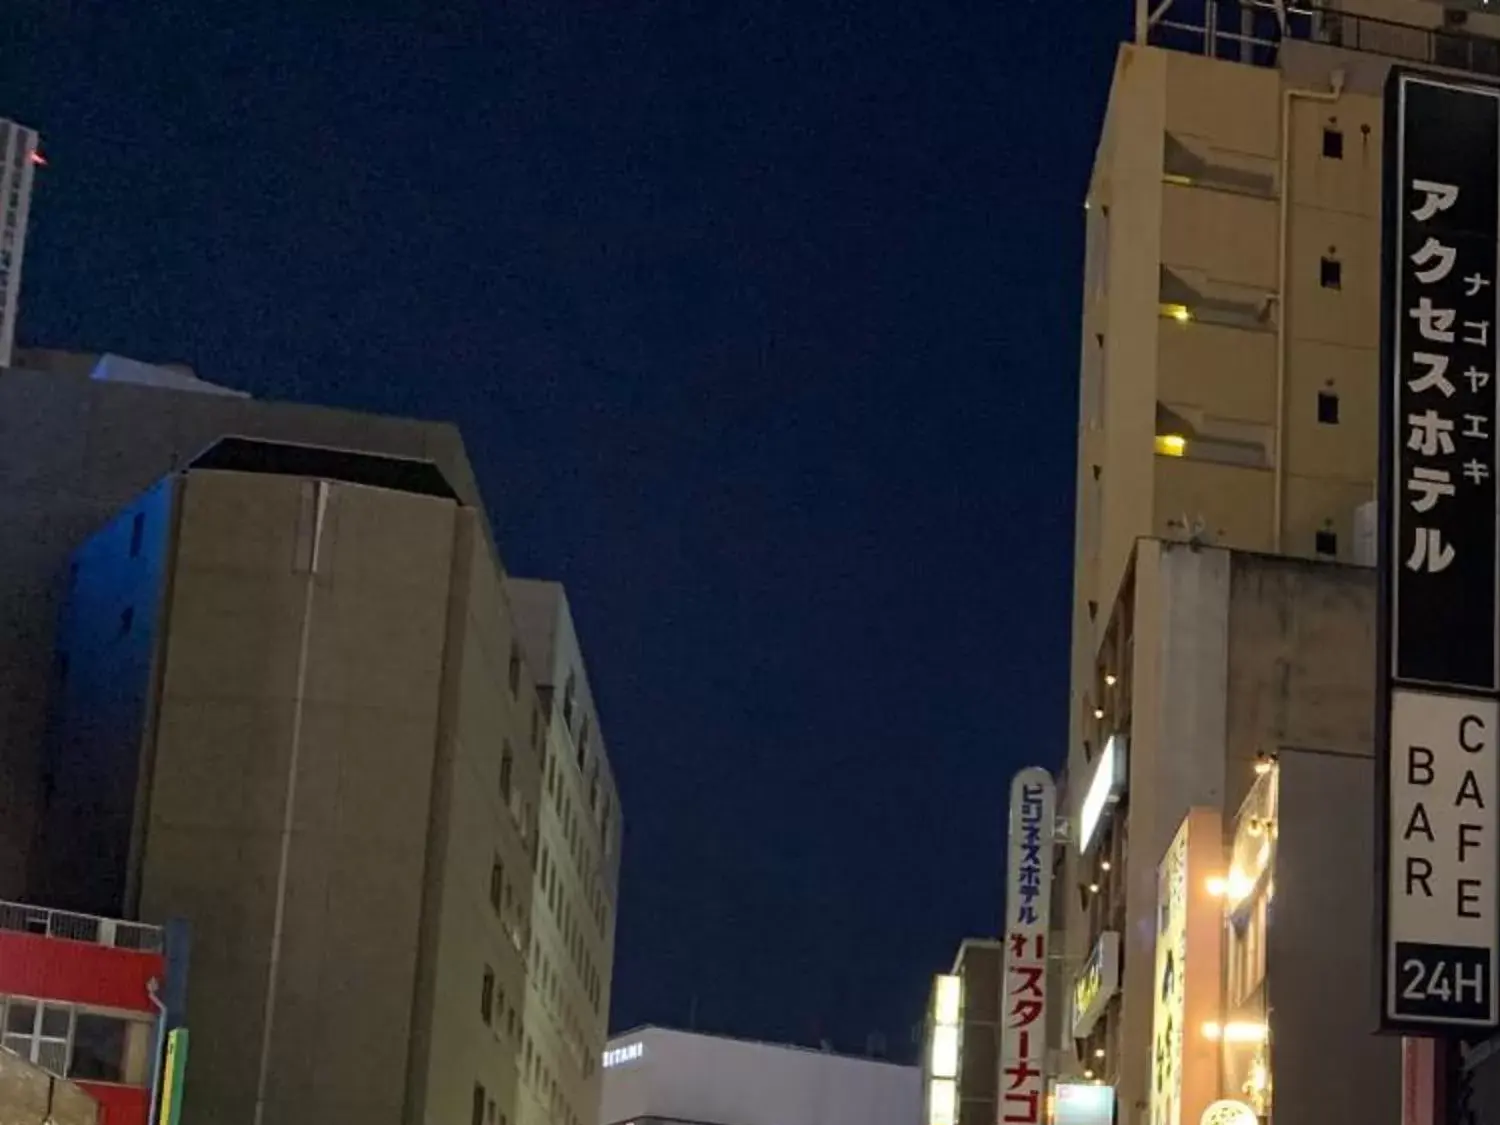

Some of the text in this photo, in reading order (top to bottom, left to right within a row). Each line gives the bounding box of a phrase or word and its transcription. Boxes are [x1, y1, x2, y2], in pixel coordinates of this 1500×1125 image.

[1406, 178, 1459, 574] アクセスホテル
[1463, 272, 1490, 486] ナゴヤエキ
[1017, 783, 1044, 925] ビジネスホテル
[1404, 746, 1436, 897] BAR
[1455, 714, 1485, 918] CAFE
[1402, 957, 1484, 1004] 24H
